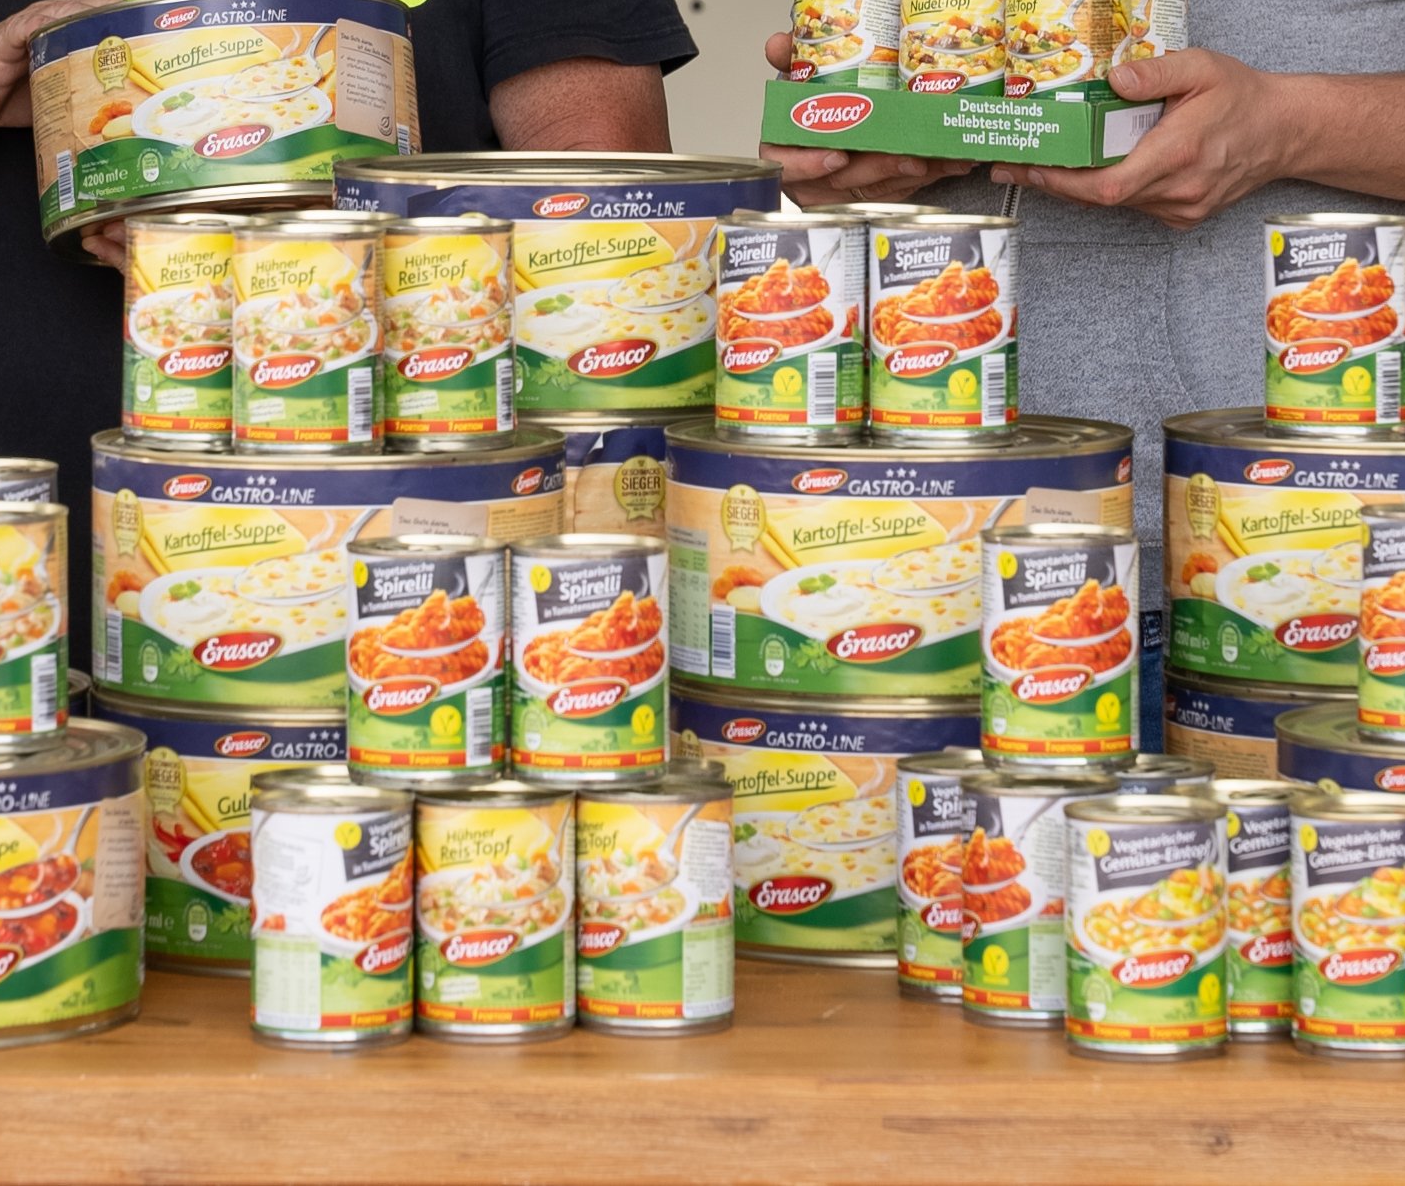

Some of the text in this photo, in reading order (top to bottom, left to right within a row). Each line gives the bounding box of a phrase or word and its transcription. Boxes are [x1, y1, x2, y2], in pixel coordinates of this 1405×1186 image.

[160, 8, 287, 28] Erasco GASTRO-LINE
[154, 36, 263, 74] Kartoffel-Suppe
[912, 75, 960, 93] Erasco
[802, 101, 865, 127] Erasco
[960, 100, 1043, 117] Deutschlands
[943, 113, 1059, 134] beliebteste Suppen
[203, 128, 265, 157] Erasco
[963, 132, 1040, 150] und Eintöpfe
[539, 198, 686, 218] Erasco GASTRO-LINE
[528, 235, 657, 267] Kartoffel-Suppe
[728, 233, 778, 248] Vegetarische
[895, 235, 952, 251] Vegetarische
[1289, 232, 1347, 247] Vegetarische
[167, 250, 215, 266] Hühner
[255, 258, 300, 273] Hühner
[405, 251, 452, 267] Hühner
[729, 244, 777, 266] Spirelli
[896, 245, 950, 270] Spirelli
[1289, 243, 1346, 266] Spirelli
[164, 349, 228, 374] Erasco
[254, 357, 316, 384] Erasco
[404, 351, 467, 378] Erasco
[578, 343, 651, 374] Erasco
[724, 347, 774, 369] Erasco
[890, 351, 949, 373] Erasco
[1284, 348, 1343, 370] Erasco
[621, 475, 661, 492] SIEGER
[798, 473, 955, 496] Erasco GASTRO-LINE
[1250, 463, 1399, 489] Erasco GASTRO-LINE
[169, 478, 315, 504] Erasco GASTRO-LINE
[726, 506, 760, 521] SIEGER
[164, 522, 286, 551] Kartoffel-Suppe
[793, 515, 927, 545] Kartoffel-Suppe
[373, 562, 435, 580] Vegetarische
[1024, 551, 1088, 568] Vegetarische
[374, 573, 433, 599] Spirelli
[558, 565, 623, 582] Vegetarische
[1024, 562, 1087, 589] Spirelli
[559, 575, 621, 602] Spirelli
[837, 629, 915, 657] Erasco
[1284, 618, 1357, 646] Erasco
[201, 637, 275, 665] Erasco
[368, 685, 432, 709] Erasco
[1018, 671, 1086, 699] Erasco
[554, 687, 621, 713] Erasco
[222, 736, 344, 759] Erasco GASTRO-
[725, 722, 865, 751] Erasco GASTRO-LINE
[447, 827, 495, 843] Hühner
[1229, 830, 1291, 856] Gemüse-
[757, 881, 826, 907] Erasco
[446, 935, 513, 963] Erasco
[578, 928, 620, 951] rasco
[1249, 935, 1291, 963] Eras
[1118, 953, 1190, 984] Erasco
[1324, 952, 1395, 981] Erasco
